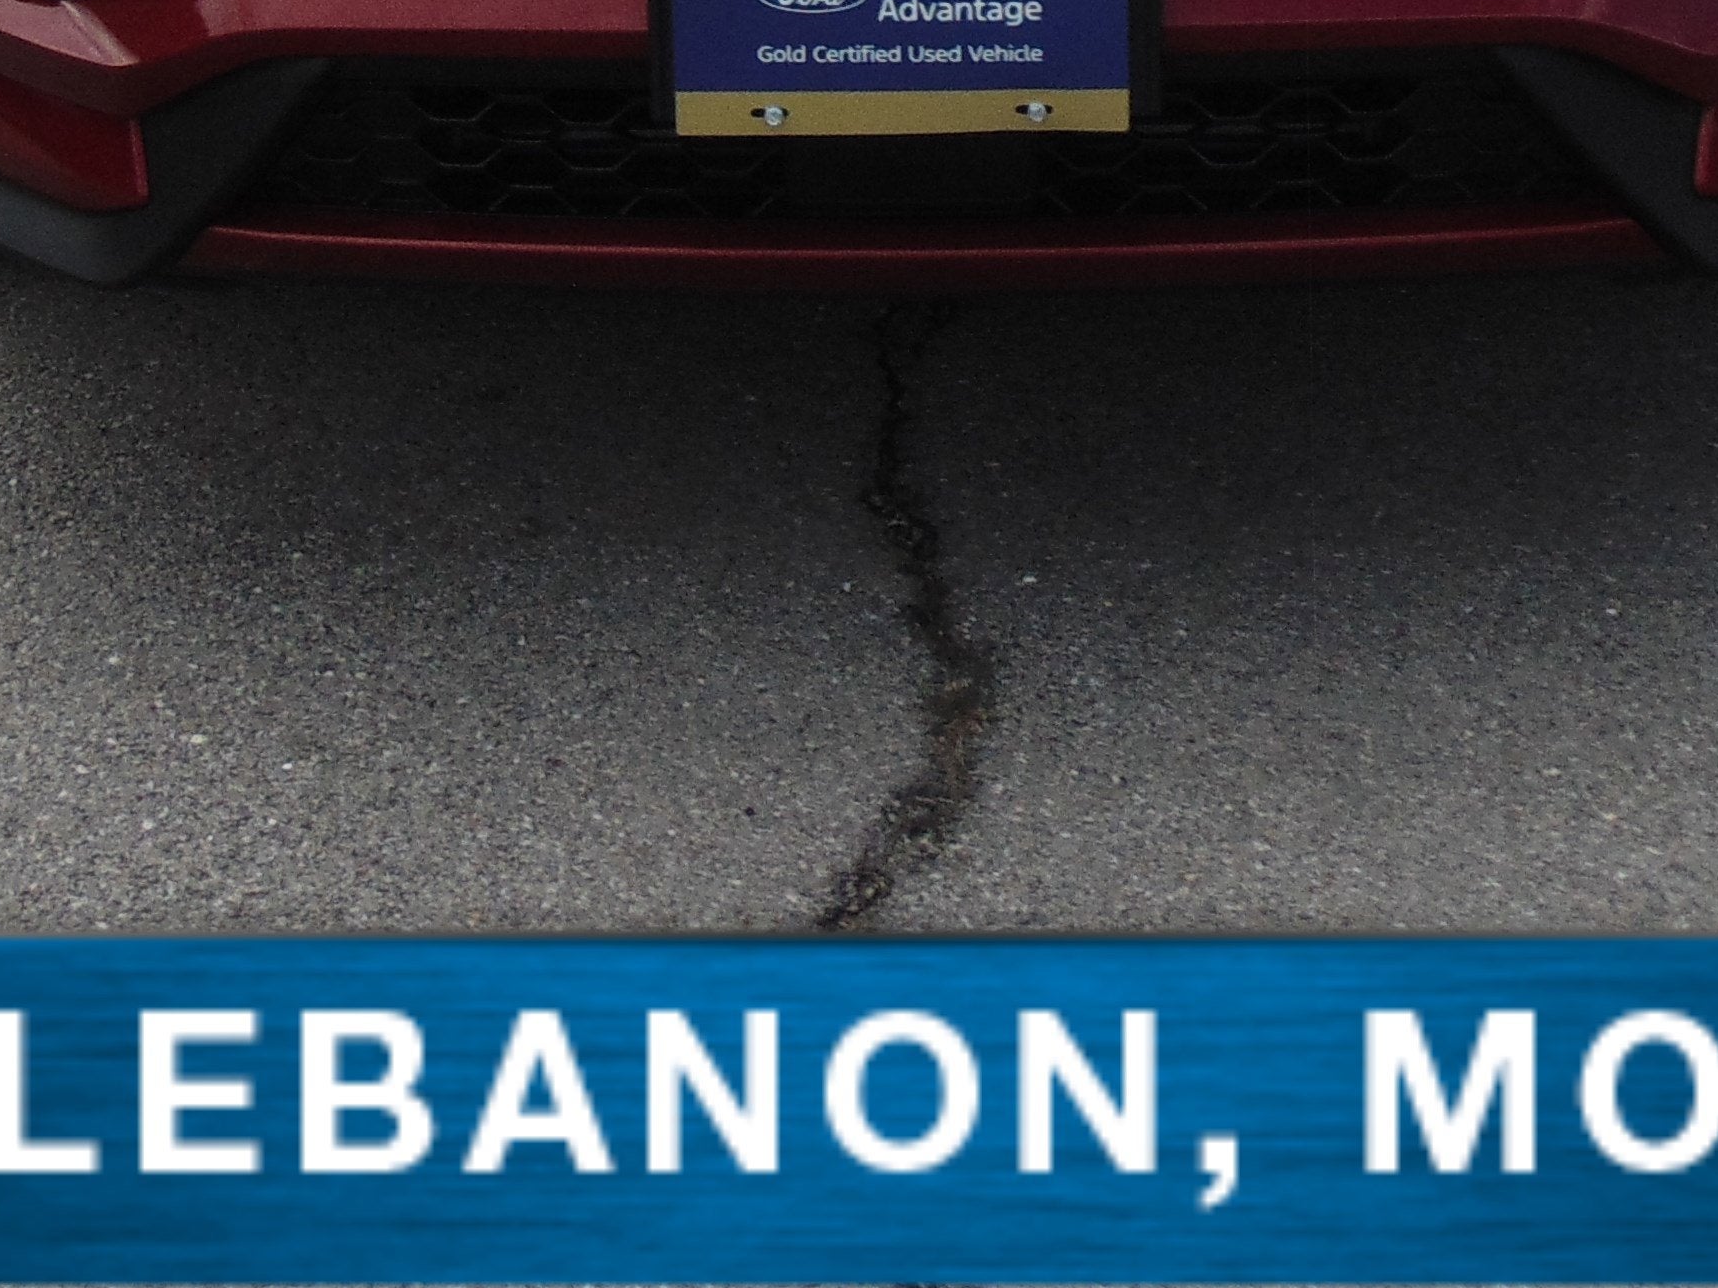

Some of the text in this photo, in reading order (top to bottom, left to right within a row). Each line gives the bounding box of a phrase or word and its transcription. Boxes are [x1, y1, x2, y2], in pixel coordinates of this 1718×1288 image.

[756, 43, 1044, 63] Gold Certified Used Vehicle
